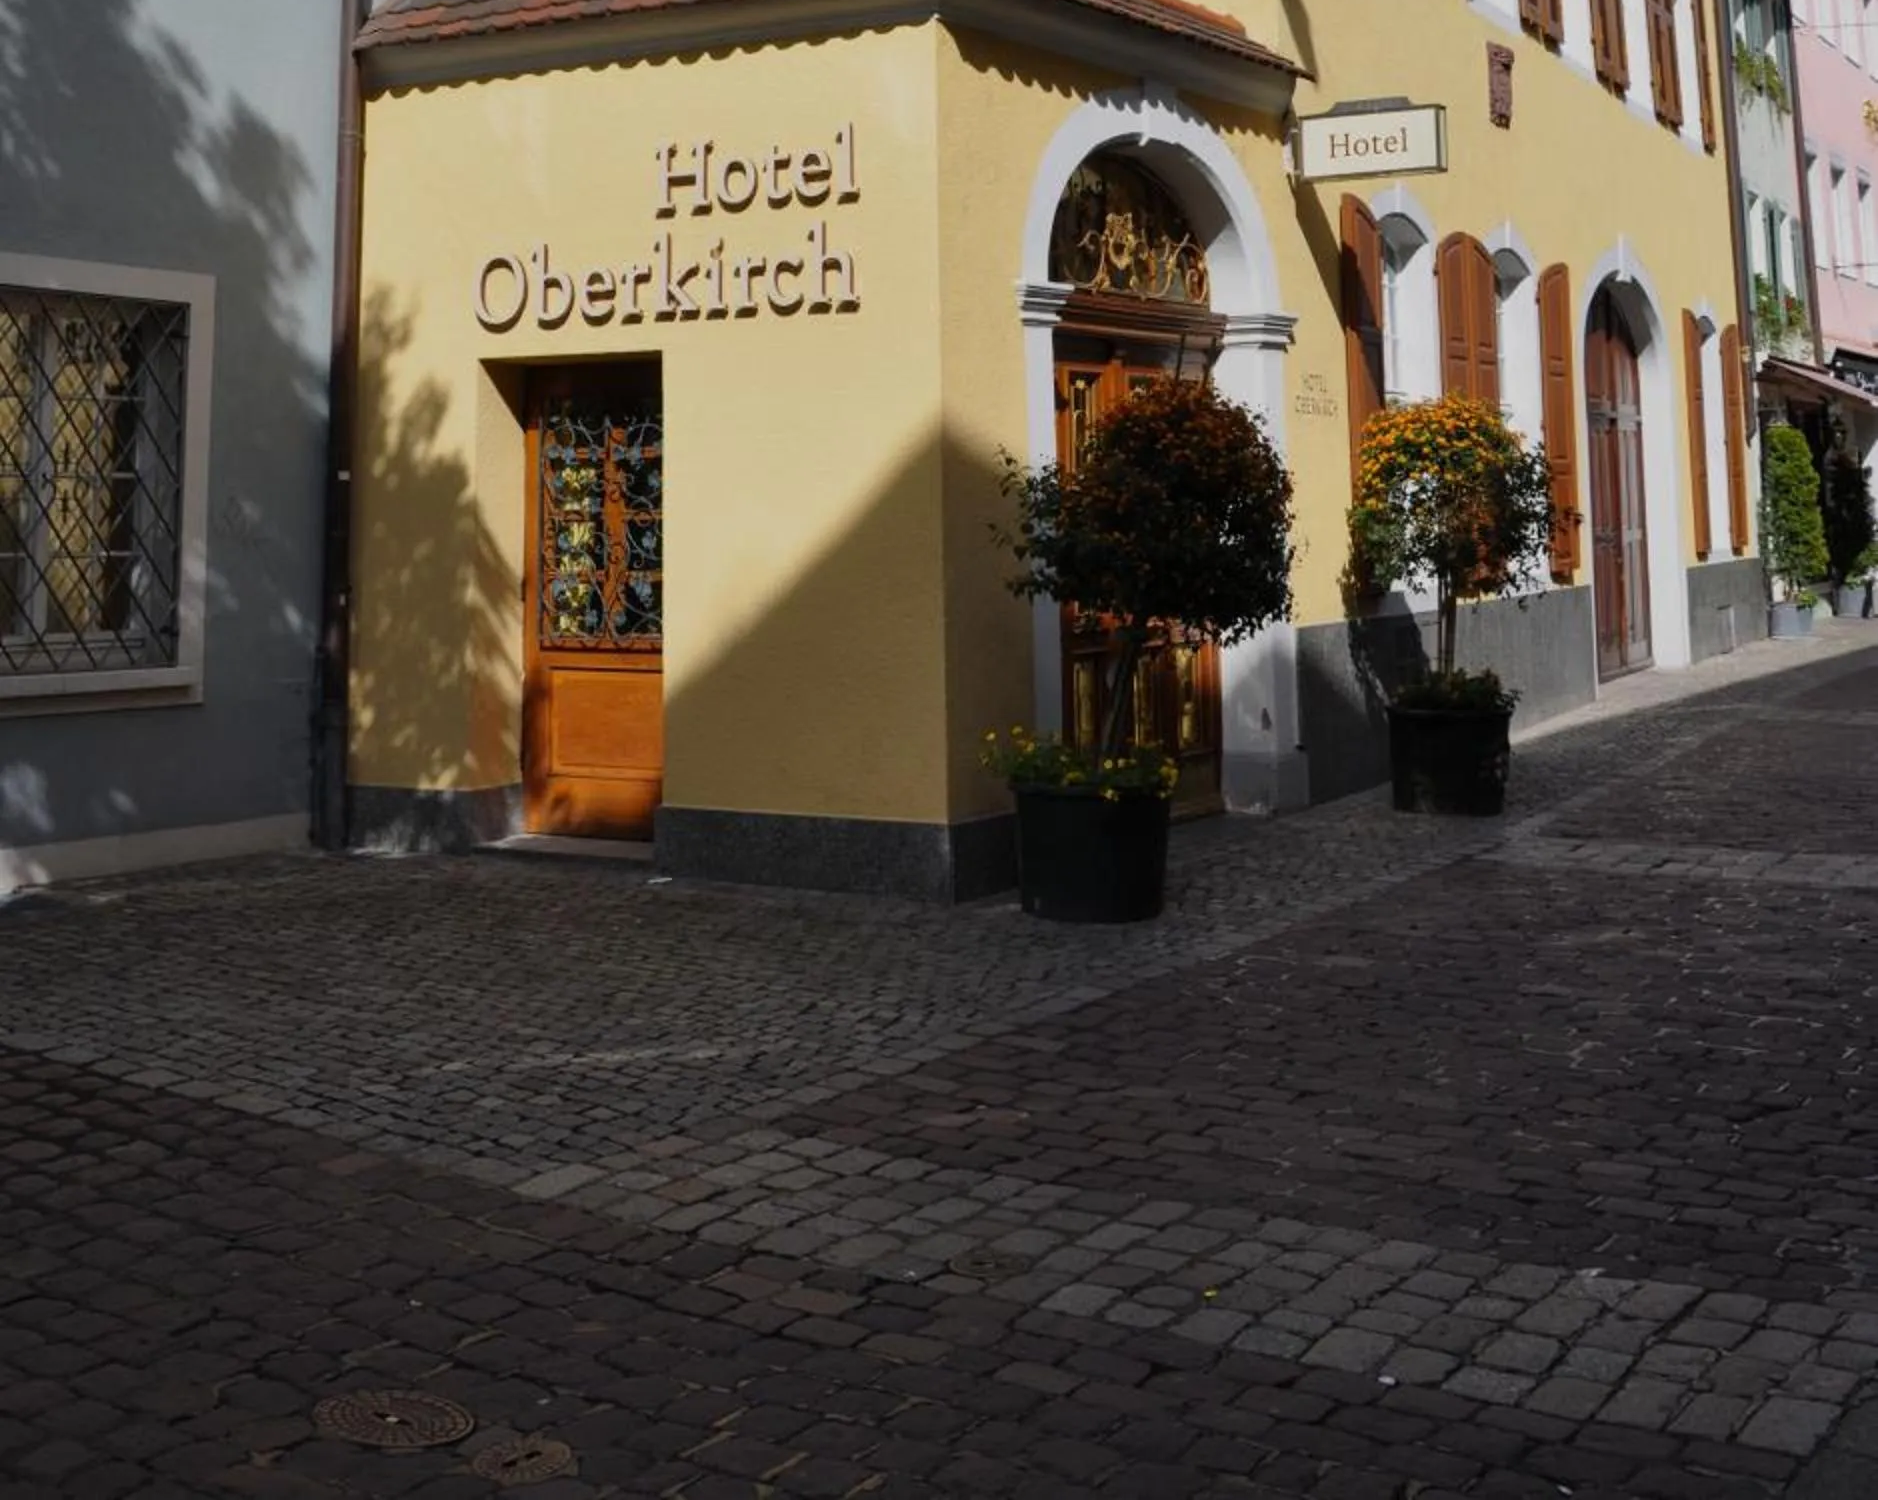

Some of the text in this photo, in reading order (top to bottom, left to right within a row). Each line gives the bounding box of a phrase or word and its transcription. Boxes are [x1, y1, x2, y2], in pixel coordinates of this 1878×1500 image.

[655, 121, 861, 219] Hotel
[1329, 127, 1408, 159] Hotel
[473, 220, 861, 334] Oberkirch
